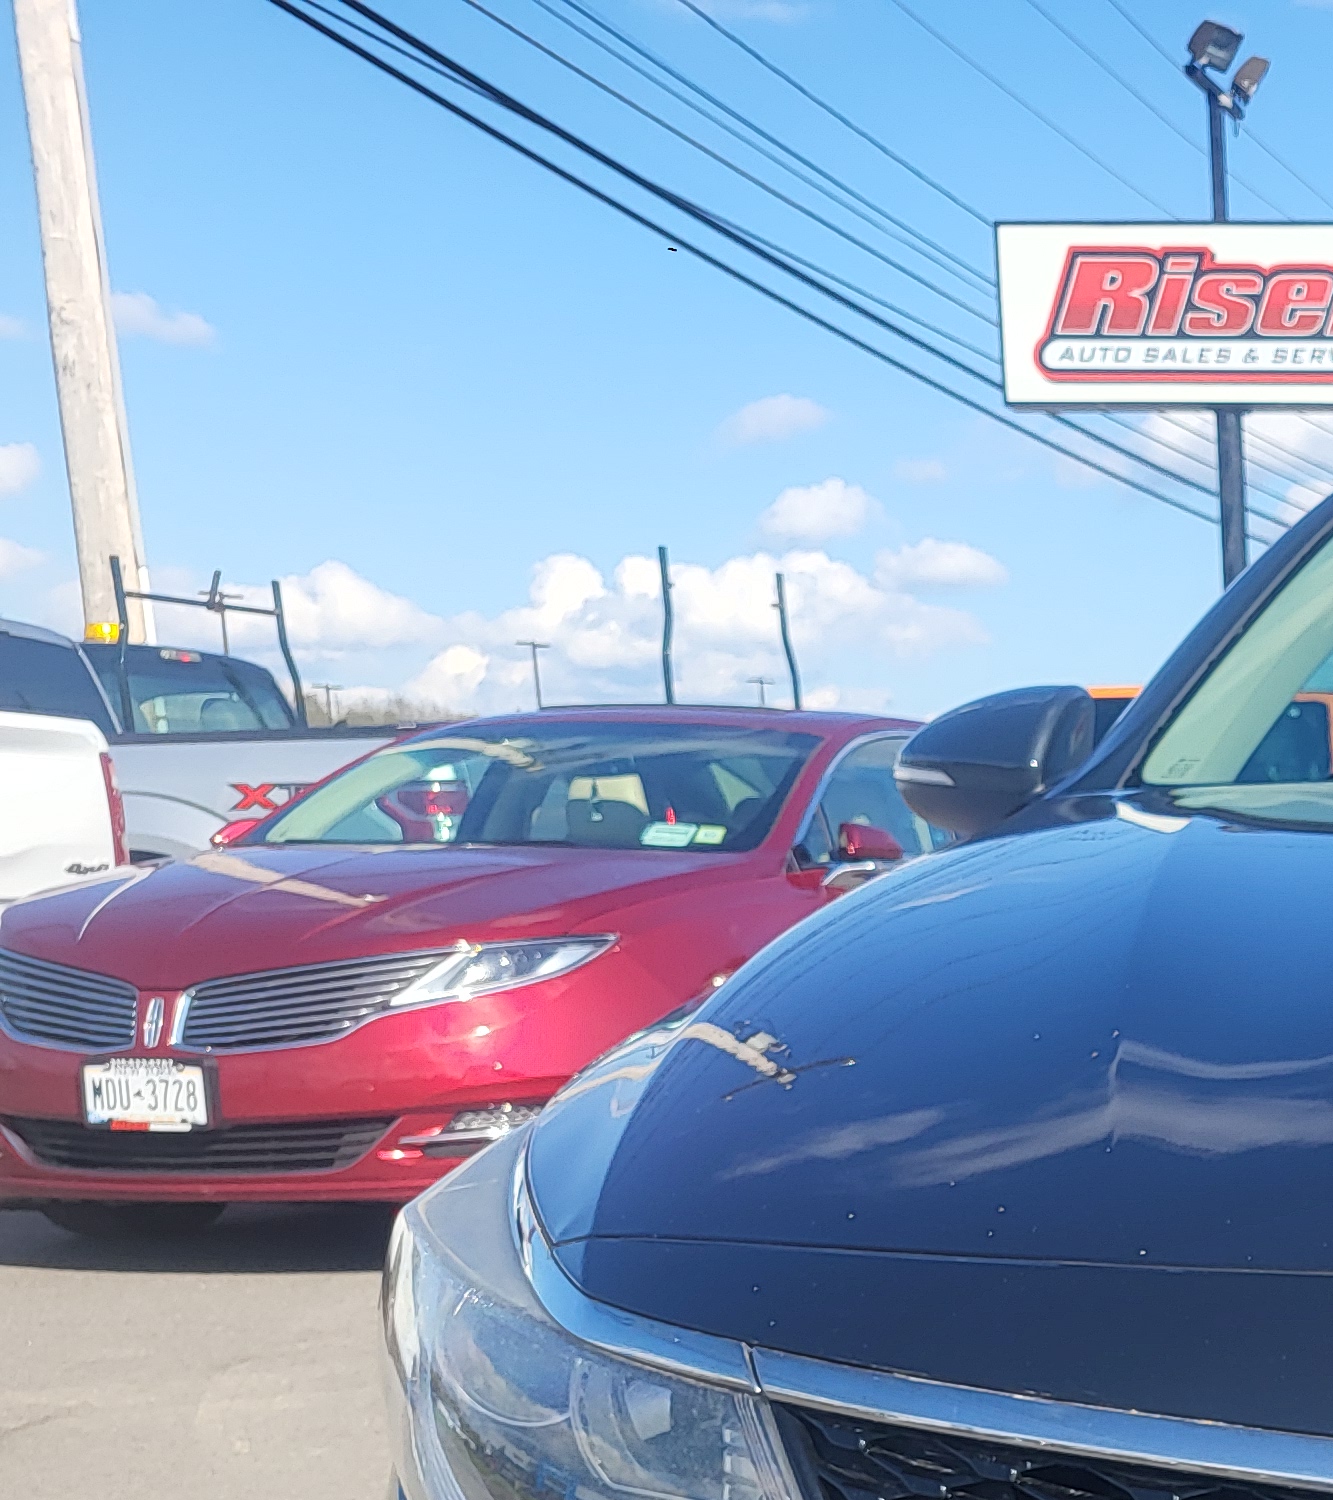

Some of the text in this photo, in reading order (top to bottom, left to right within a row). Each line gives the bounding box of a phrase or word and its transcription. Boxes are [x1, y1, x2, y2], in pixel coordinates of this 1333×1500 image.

[1058, 345, 1132, 364] AUTO
[1142, 345, 1232, 364] SALES
[1241, 346, 1260, 364] &
[145, 1078, 198, 1113] 3728
